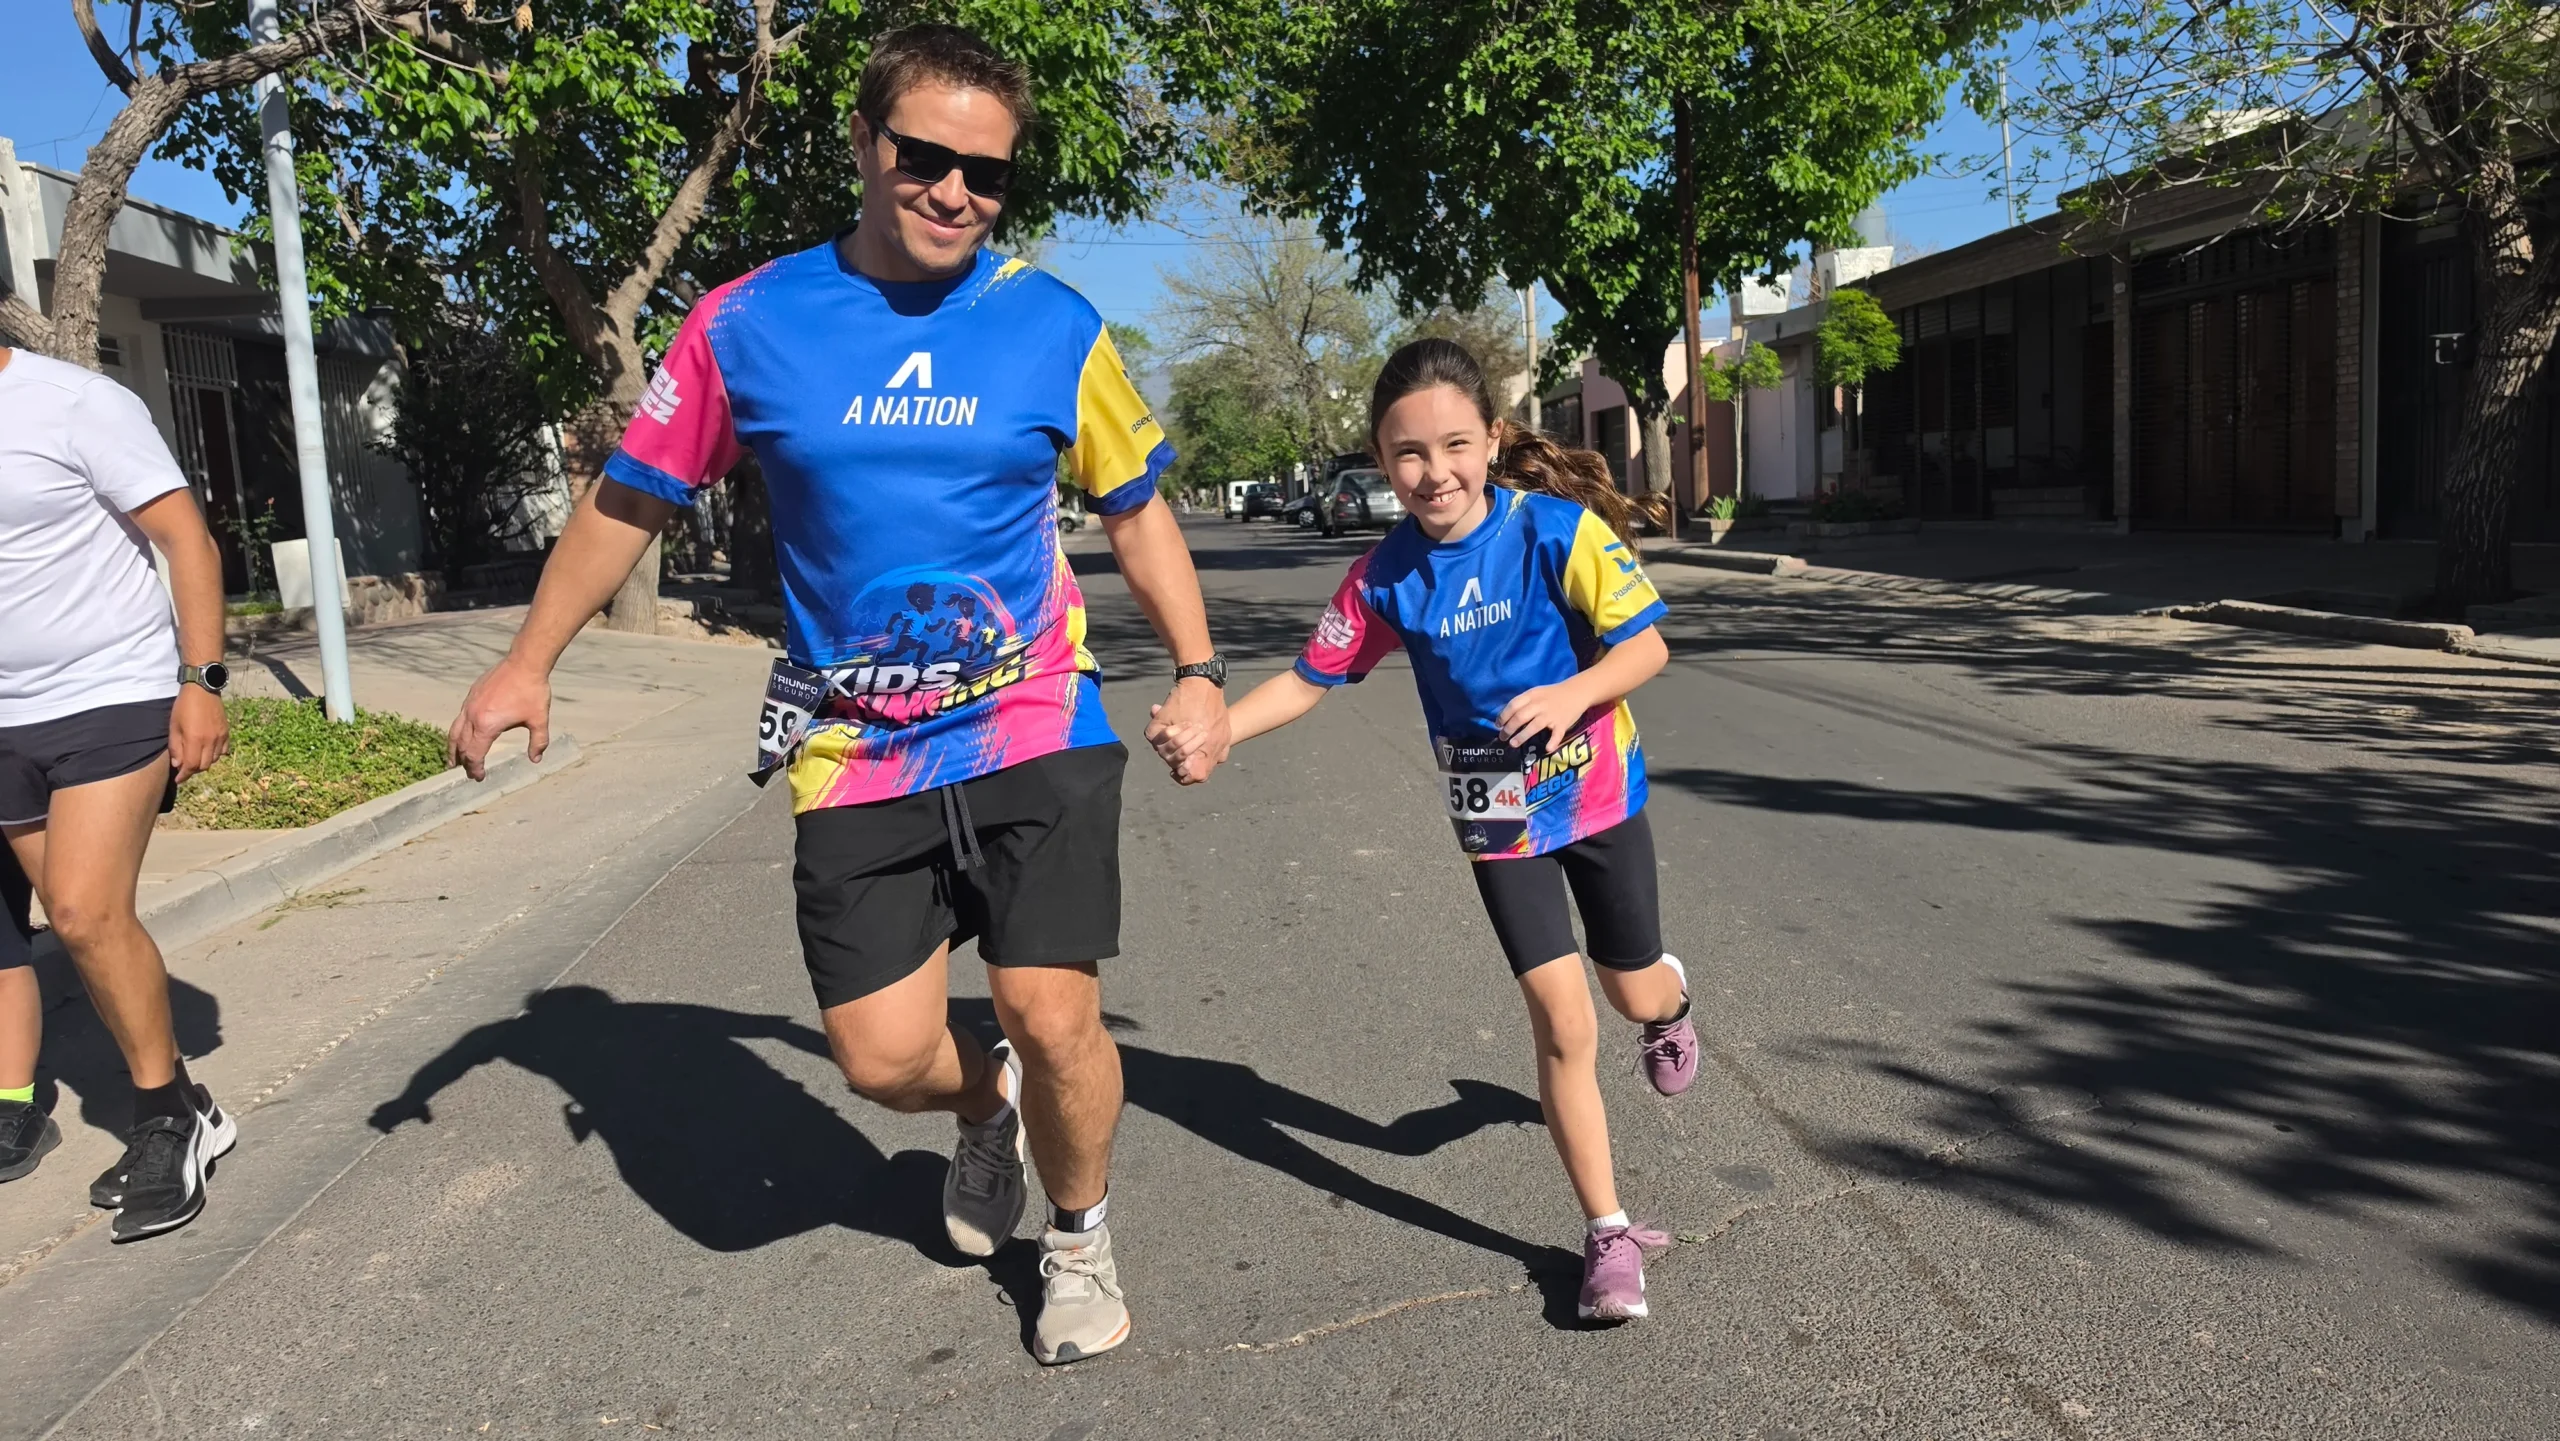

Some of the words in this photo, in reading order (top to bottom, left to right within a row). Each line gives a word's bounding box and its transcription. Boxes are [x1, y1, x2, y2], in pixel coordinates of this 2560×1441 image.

[842, 395, 863, 425] A
[869, 396, 978, 426] NATION
[1612, 579, 1637, 601] Paseo
[1440, 617, 1451, 639] A
[1454, 598, 1512, 635] NATION
[772, 682, 815, 701] SEGUROS
[773, 672, 819, 695] TRIUNFO
[821, 662, 961, 698] KIDS
[760, 702, 798, 749] 59
[1457, 748, 1505, 756] TRIUNFO
[1458, 756, 1504, 764] SEGUROS
[1449, 777, 1490, 813] 58
